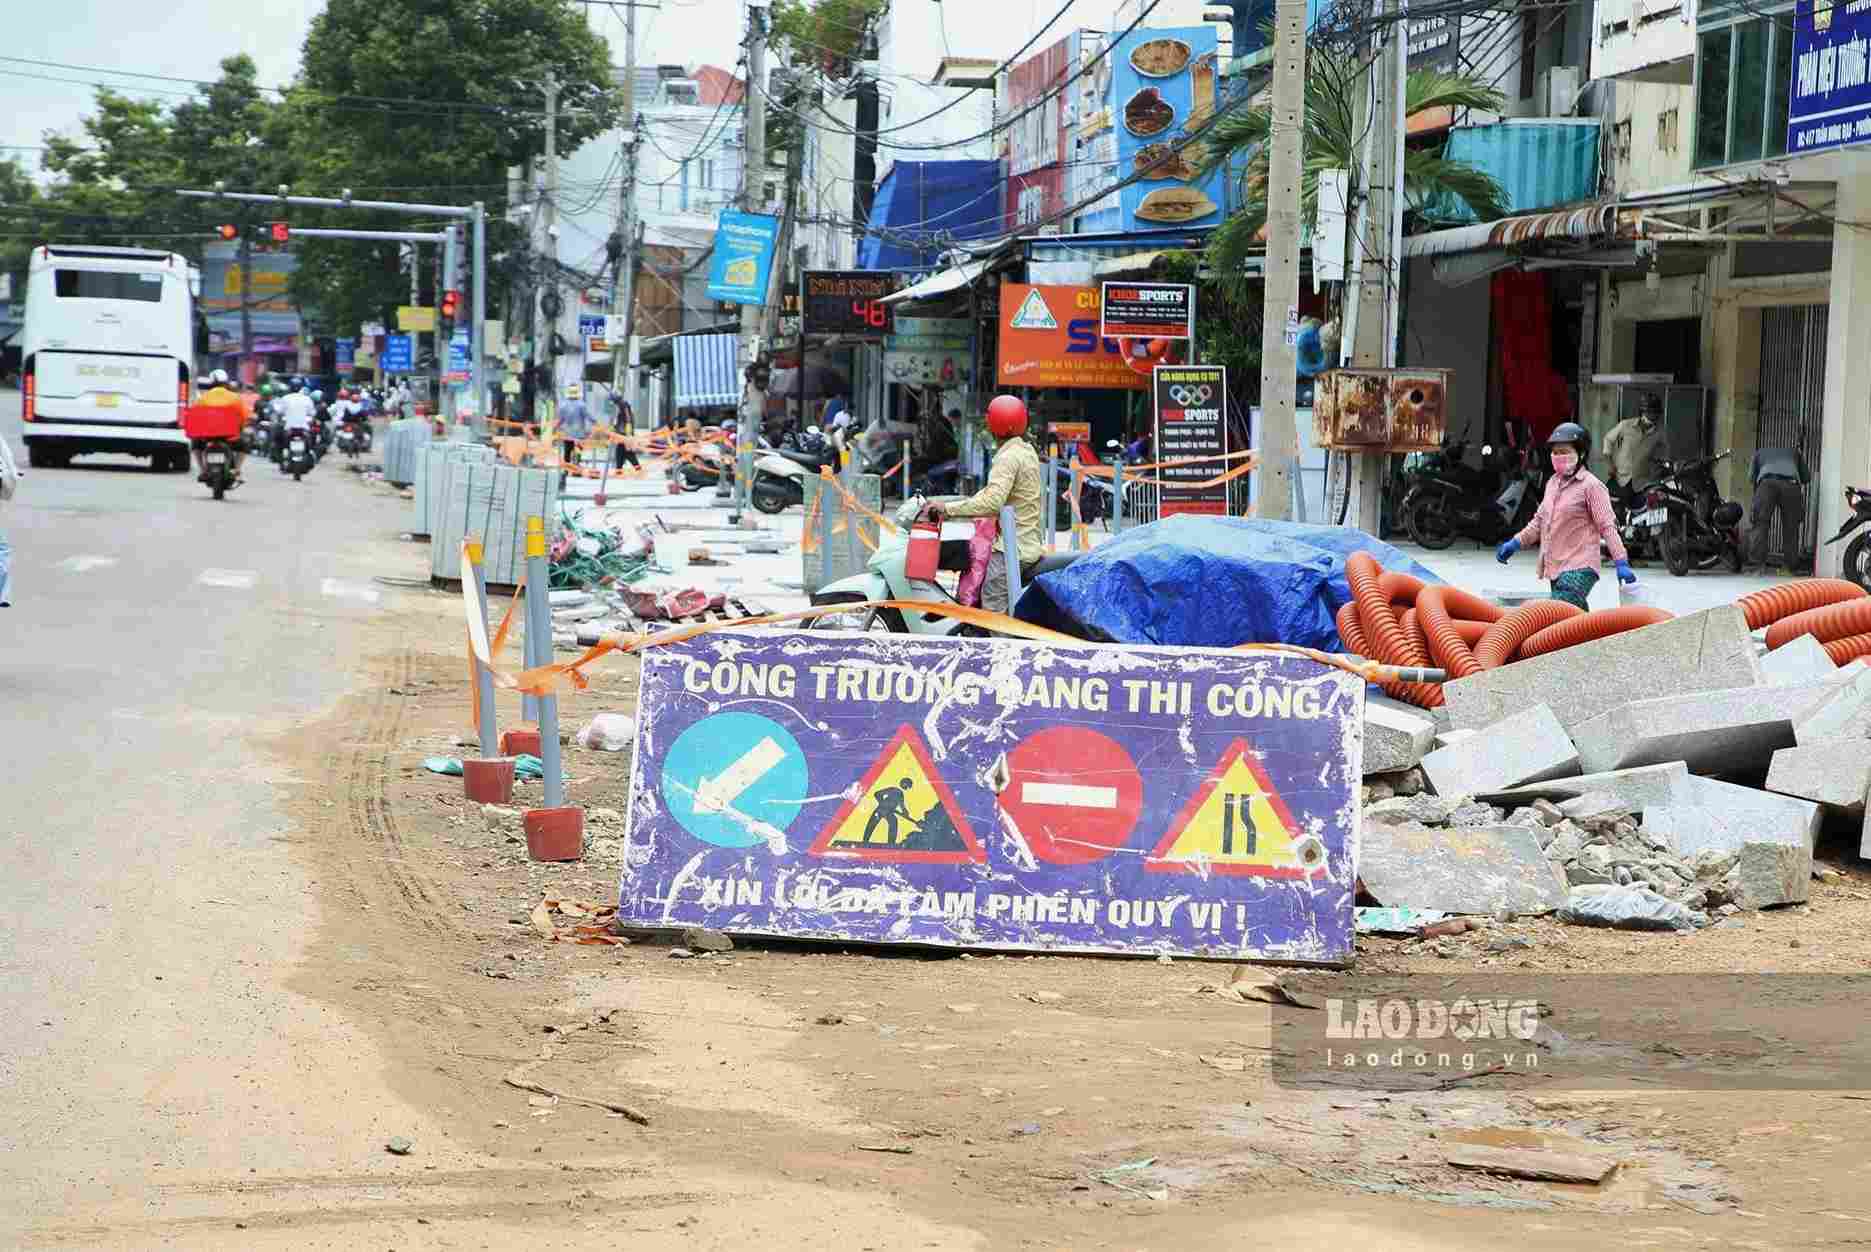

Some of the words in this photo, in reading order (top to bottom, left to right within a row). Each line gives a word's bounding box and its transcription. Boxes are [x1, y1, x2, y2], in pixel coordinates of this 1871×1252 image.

[683, 654, 796, 698] CÔNG
[1122, 679, 1192, 714] THI
[1207, 676, 1321, 719] CÔNG
[701, 877, 762, 906] XIN
[1108, 894, 1186, 928] QUÝ
[1189, 902, 1222, 936] VỊ
[1237, 903, 1246, 930] !
